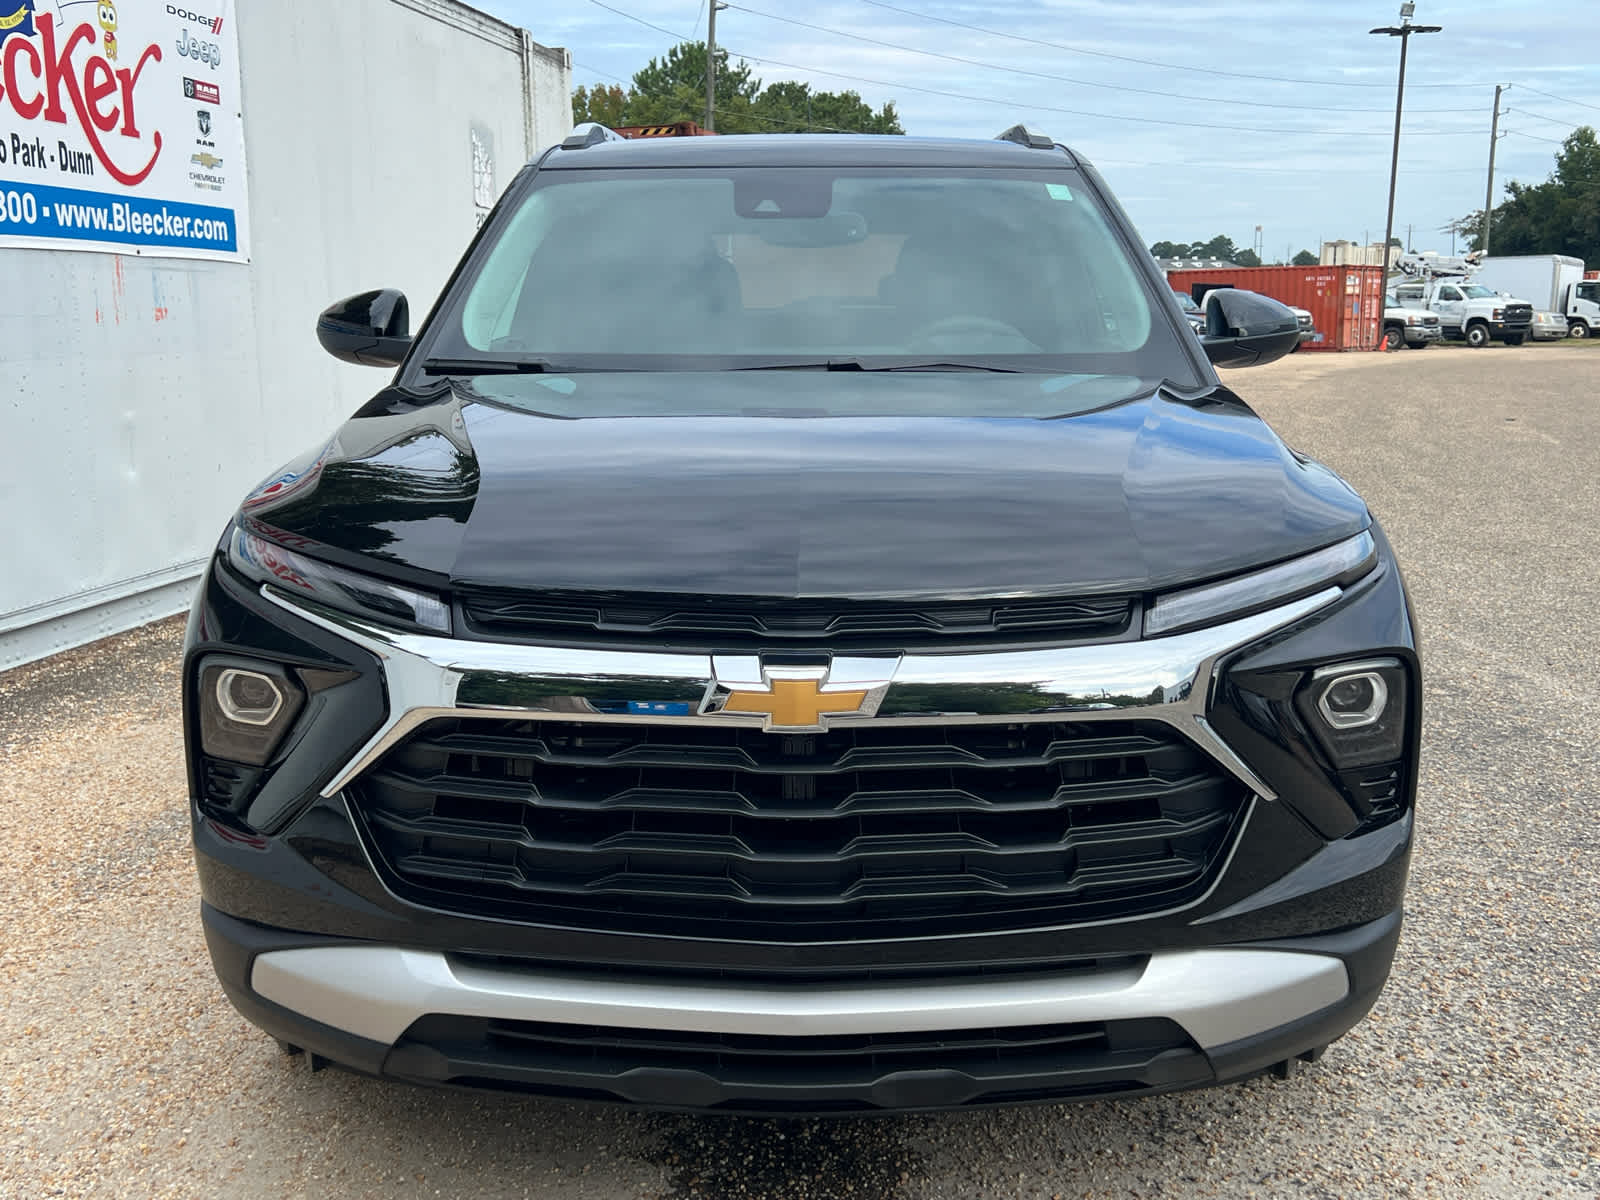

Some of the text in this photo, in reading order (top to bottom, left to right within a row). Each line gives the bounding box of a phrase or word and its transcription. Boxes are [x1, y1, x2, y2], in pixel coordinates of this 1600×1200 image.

[166, 4, 216, 28] DODGE
[176, 28, 220, 70] Jeep
[0, 12, 162, 186] cker
[196, 83, 218, 96] RAM
[10, 132, 47, 169] Park
[58, 140, 94, 176] Dunn
[196, 138, 215, 148] RAM
[189, 172, 225, 184] CHEVROLET
[54, 202, 228, 241] www.Bleecker.com
